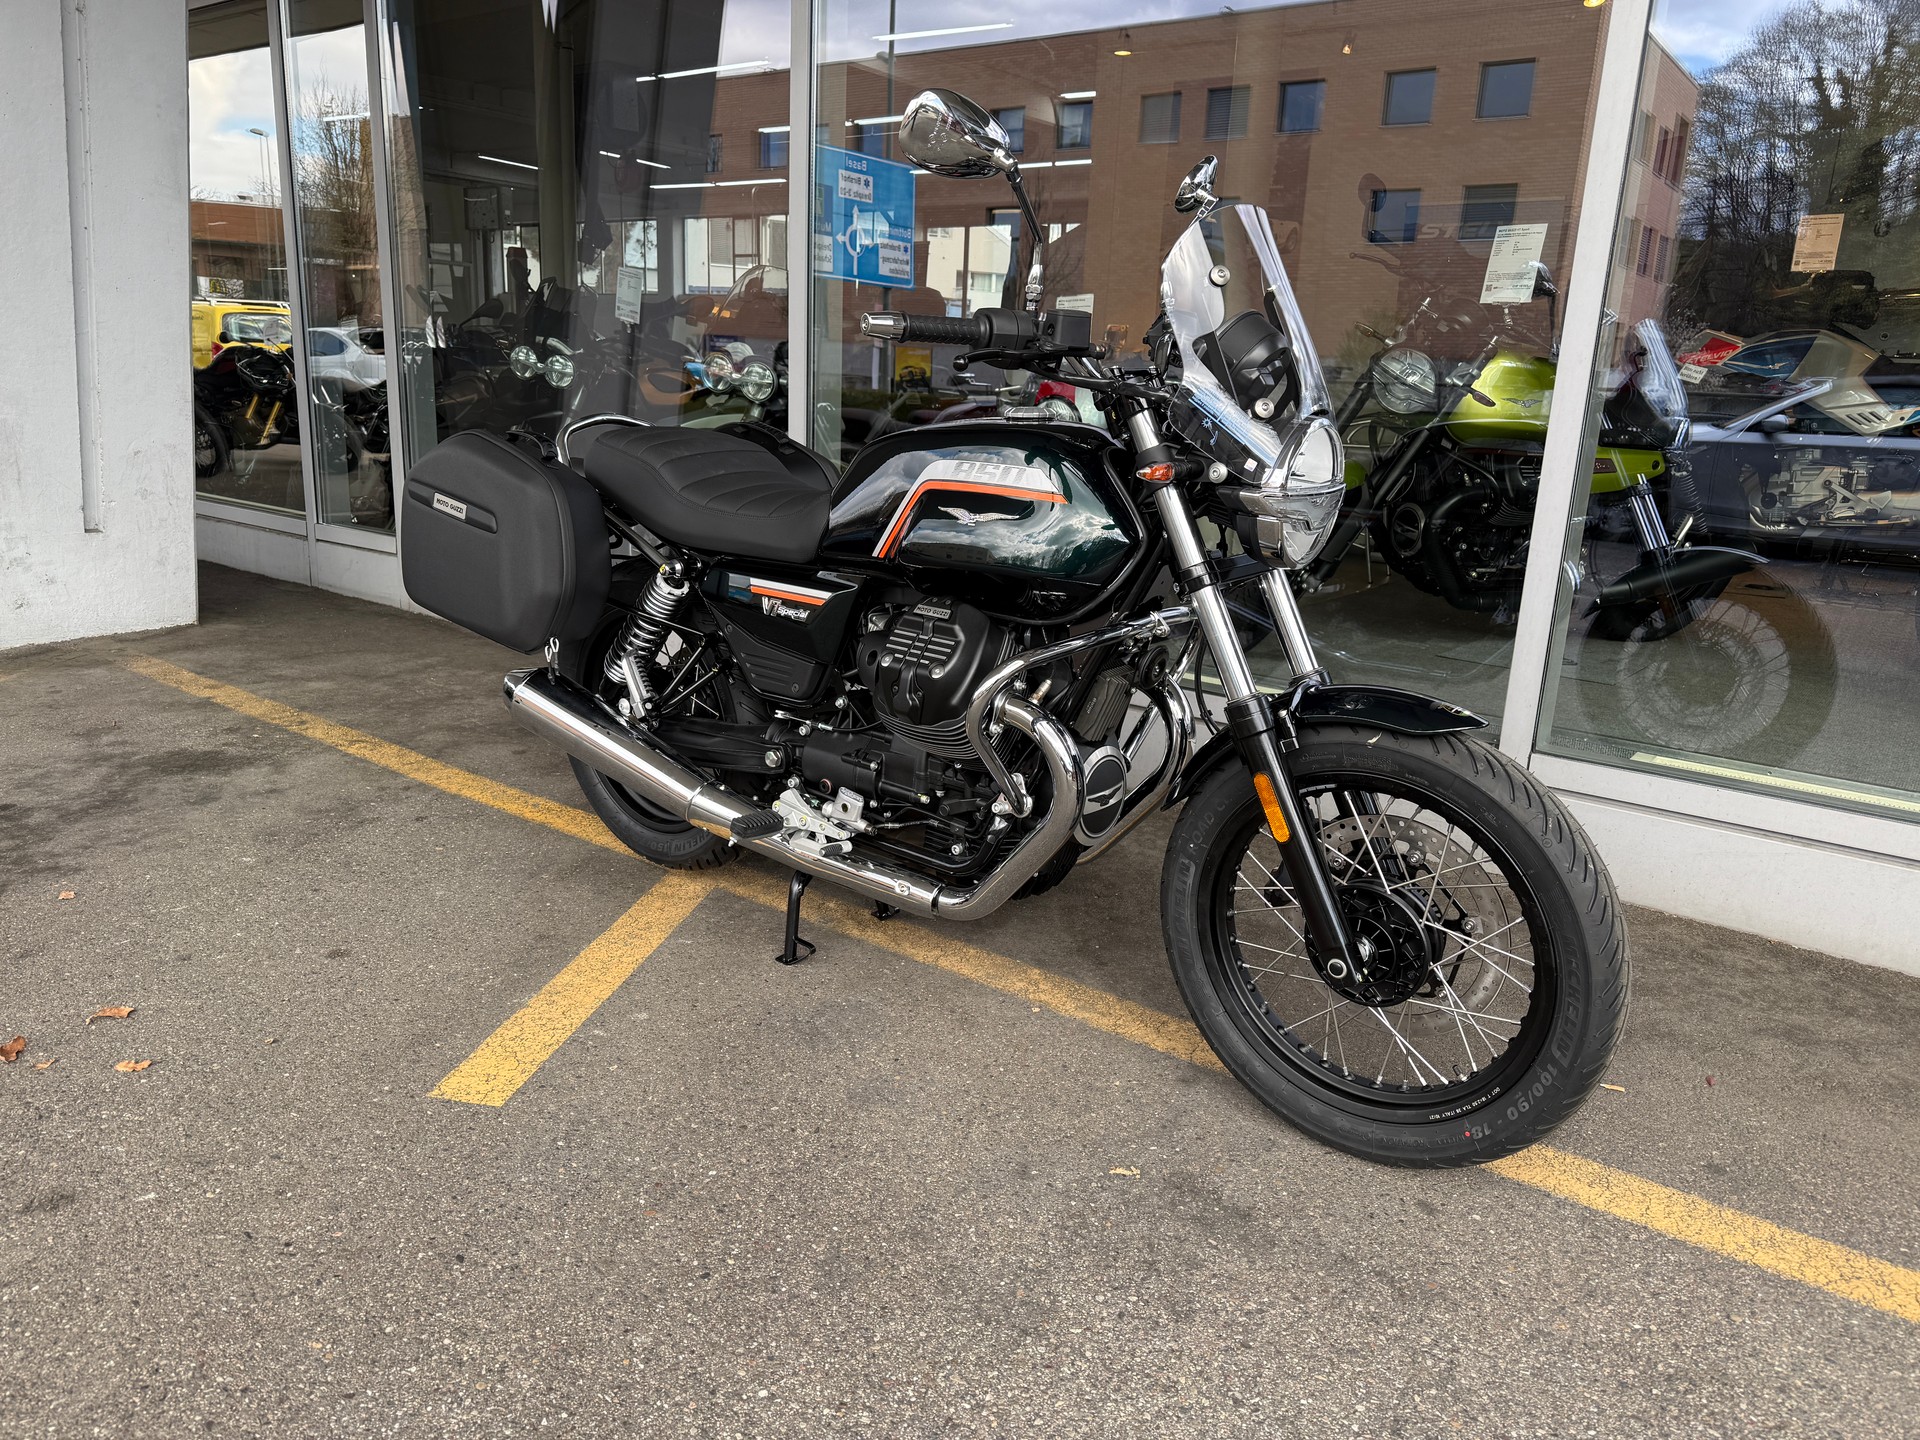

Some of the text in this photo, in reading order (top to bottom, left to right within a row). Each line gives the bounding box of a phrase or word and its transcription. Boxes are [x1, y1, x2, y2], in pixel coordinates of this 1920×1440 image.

[1687, 349, 1733, 364] STELVIO
[436, 498, 463, 514] MOTO GUZZI
[761, 596, 810, 621] V7 Special
[916, 606, 949, 617] MOTO GUZZI
[1491, 1086, 1501, 1096] DOT
[1506, 1063, 1558, 1121] 100/90
[1471, 1122, 1492, 1140] 18
